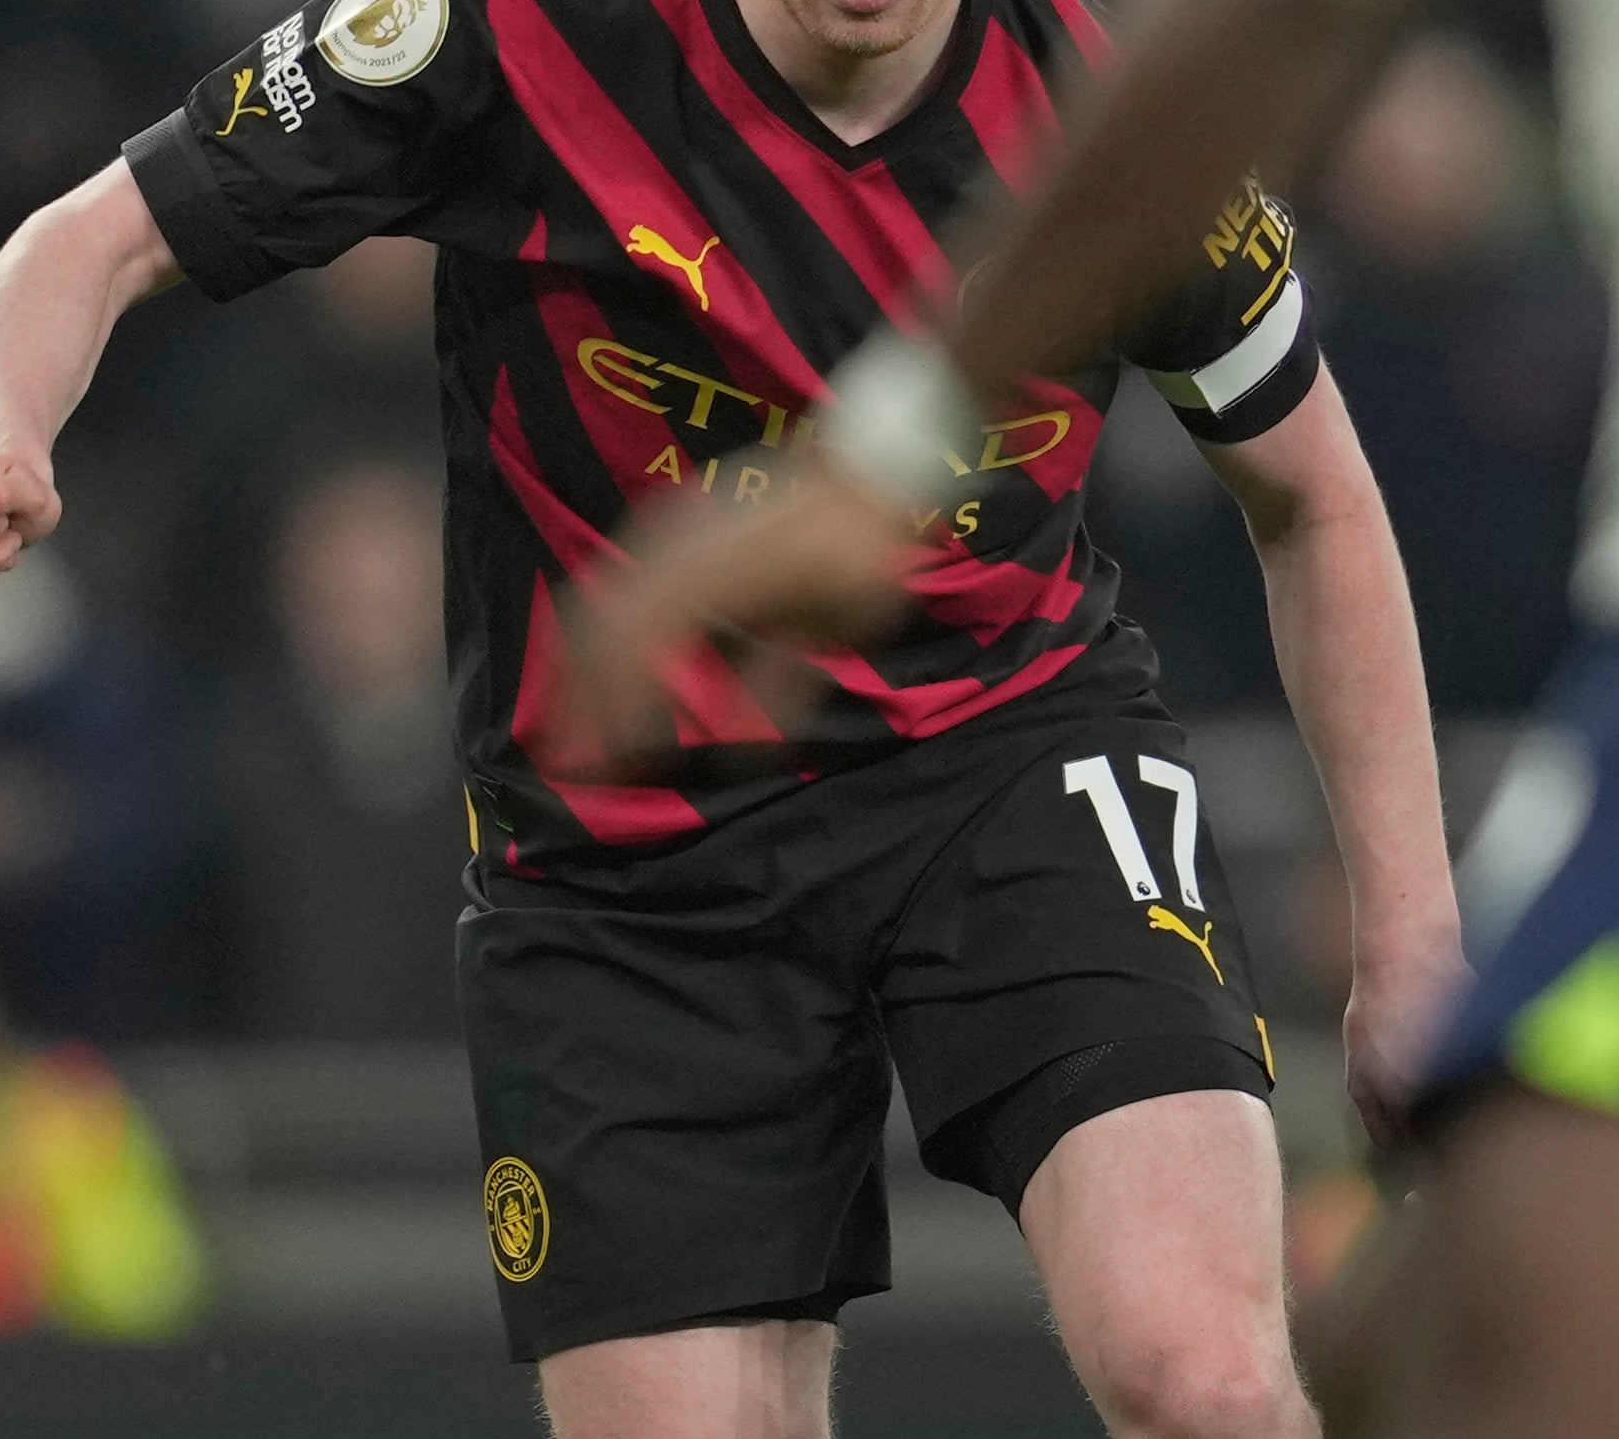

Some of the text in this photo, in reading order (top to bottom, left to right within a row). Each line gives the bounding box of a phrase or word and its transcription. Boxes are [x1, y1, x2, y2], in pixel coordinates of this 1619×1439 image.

[368, 50, 407, 67] 2021/22
[1063, 754, 1207, 913] 17
[486, 1165, 536, 1212] MANCHESTER
[512, 1257, 532, 1273] CITY
